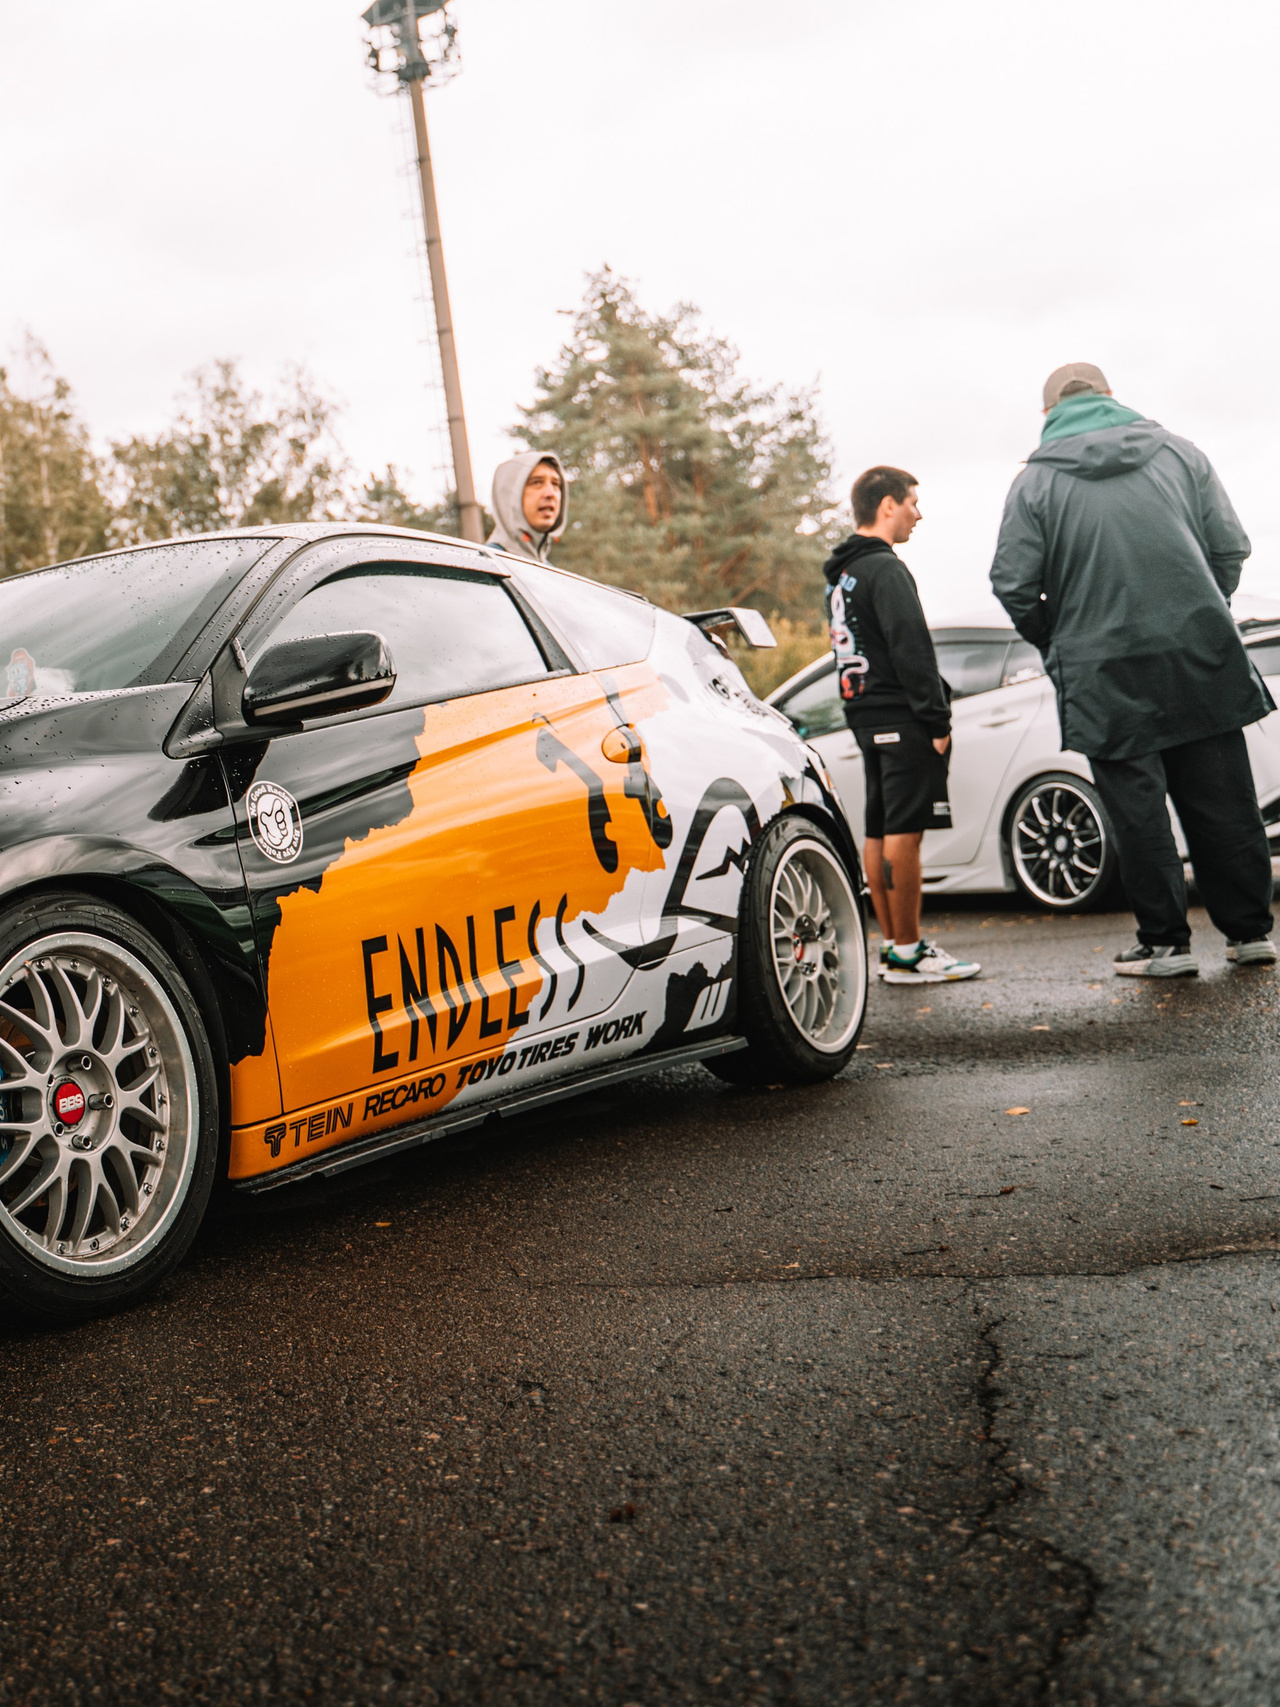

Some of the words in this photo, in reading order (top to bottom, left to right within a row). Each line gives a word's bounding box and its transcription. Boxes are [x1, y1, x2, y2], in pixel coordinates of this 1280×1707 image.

[250, 785, 267, 802] Good
[249, 802, 257, 817] No
[258, 837, 283, 860] Police
[282, 847, 296, 858] Bye
[361, 892, 586, 1074] ENDLESS
[289, 1102, 354, 1148] TEIN
[362, 1072, 447, 1121] RECARO
[517, 1032, 580, 1069] TIRES
[583, 1011, 647, 1051] WORK
[59, 1093, 84, 1114] BBS
